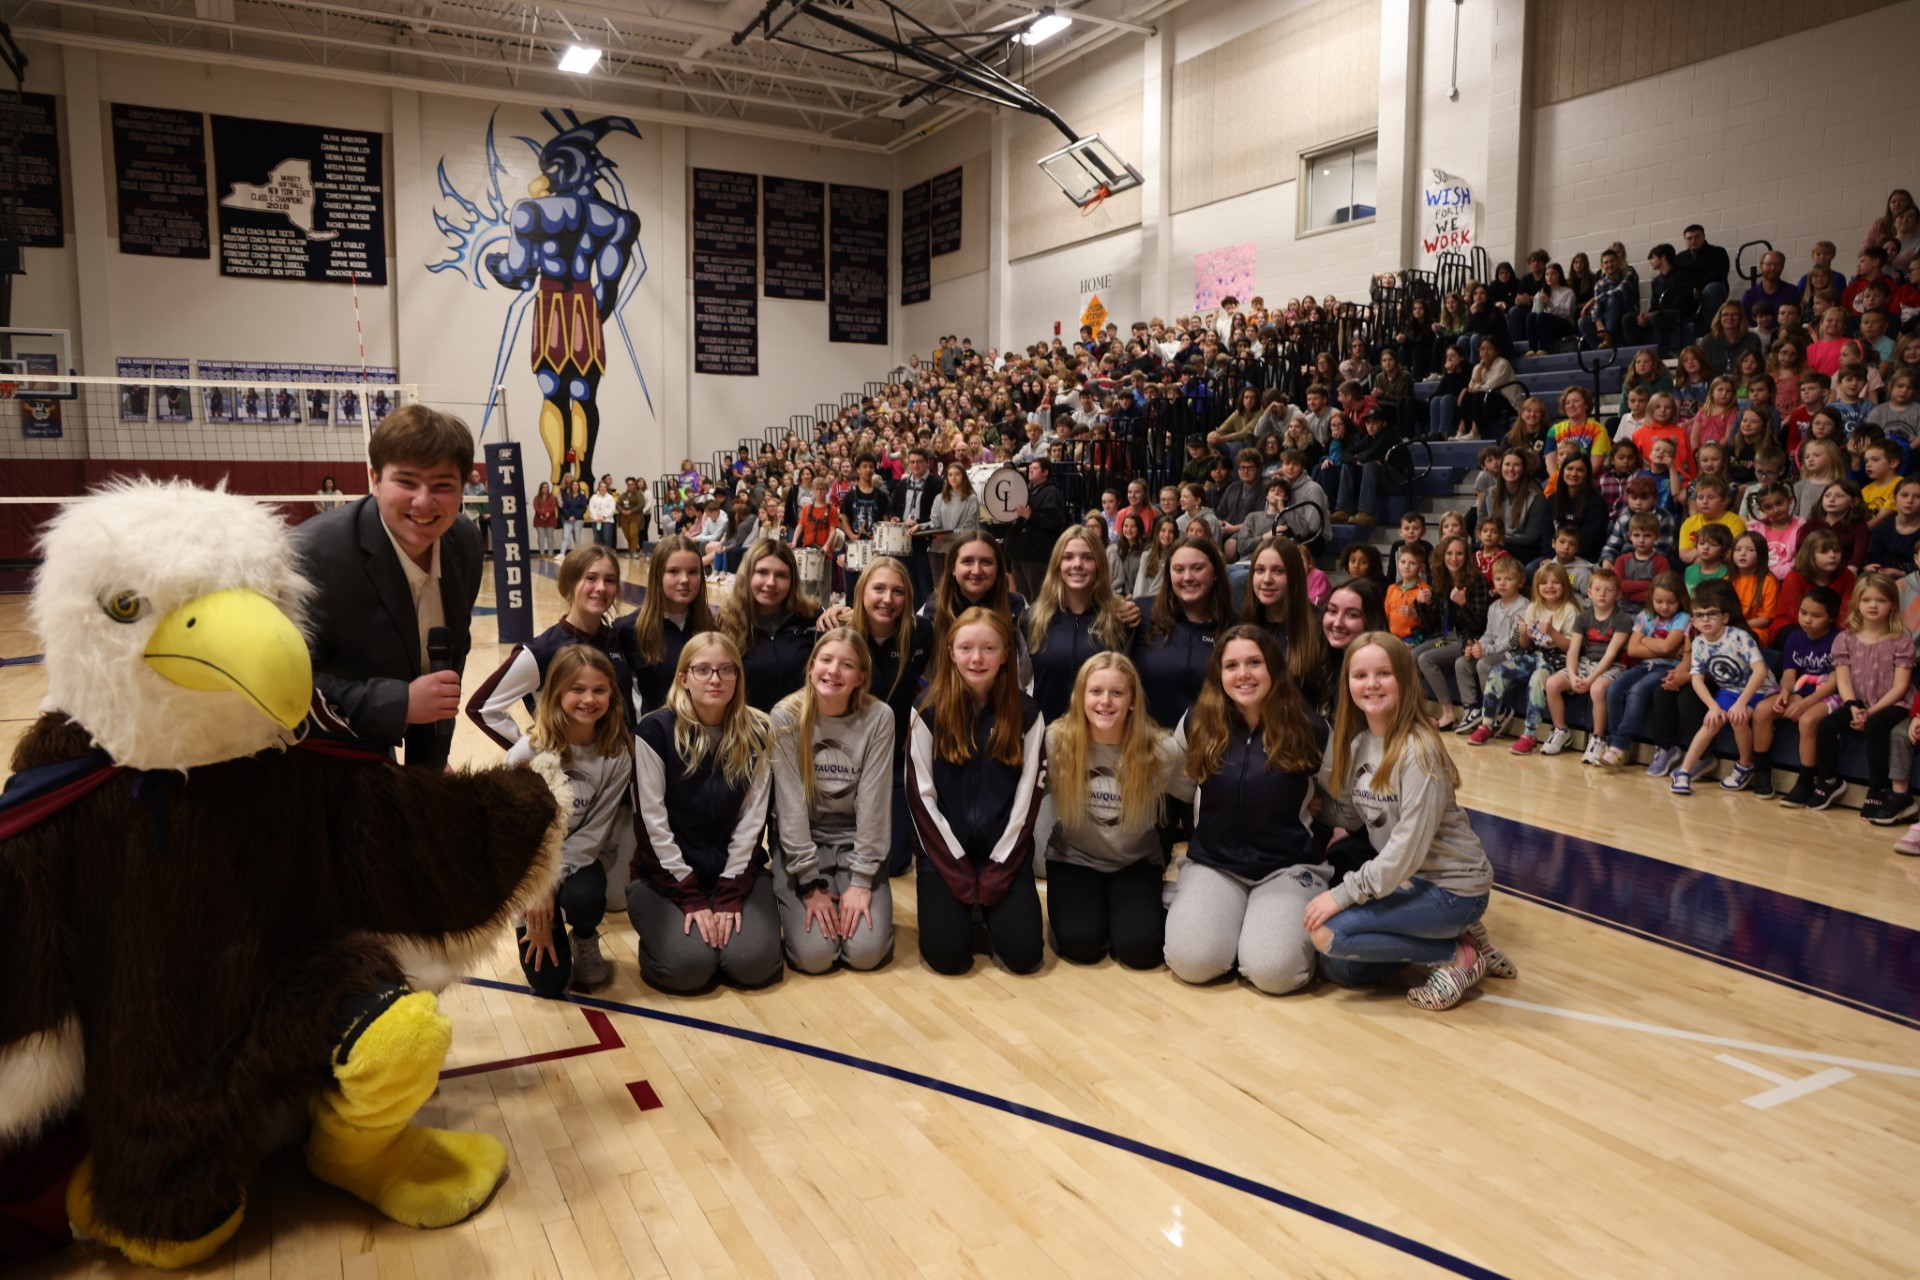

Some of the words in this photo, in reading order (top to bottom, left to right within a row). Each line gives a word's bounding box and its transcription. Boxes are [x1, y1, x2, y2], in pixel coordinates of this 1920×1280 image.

[251, 193, 267, 201] CLASS
[276, 196, 303, 205] CHAMPIONS
[268, 187, 278, 195] NEW
[281, 188, 294, 196] YORK
[296, 189, 311, 198] STATE
[1426, 186, 1470, 206] WISH
[1436, 208, 1453, 220] FOR
[1455, 205, 1464, 215] IT
[1436, 217, 1458, 234] WE
[1424, 229, 1470, 253] WORK
[1080, 274, 1112, 294] HOME
[498, 466, 515, 484] T
[501, 496, 522, 608] BIRDS
[815, 764, 849, 774] TAUQUA
[1377, 794, 1398, 802] LAKE
